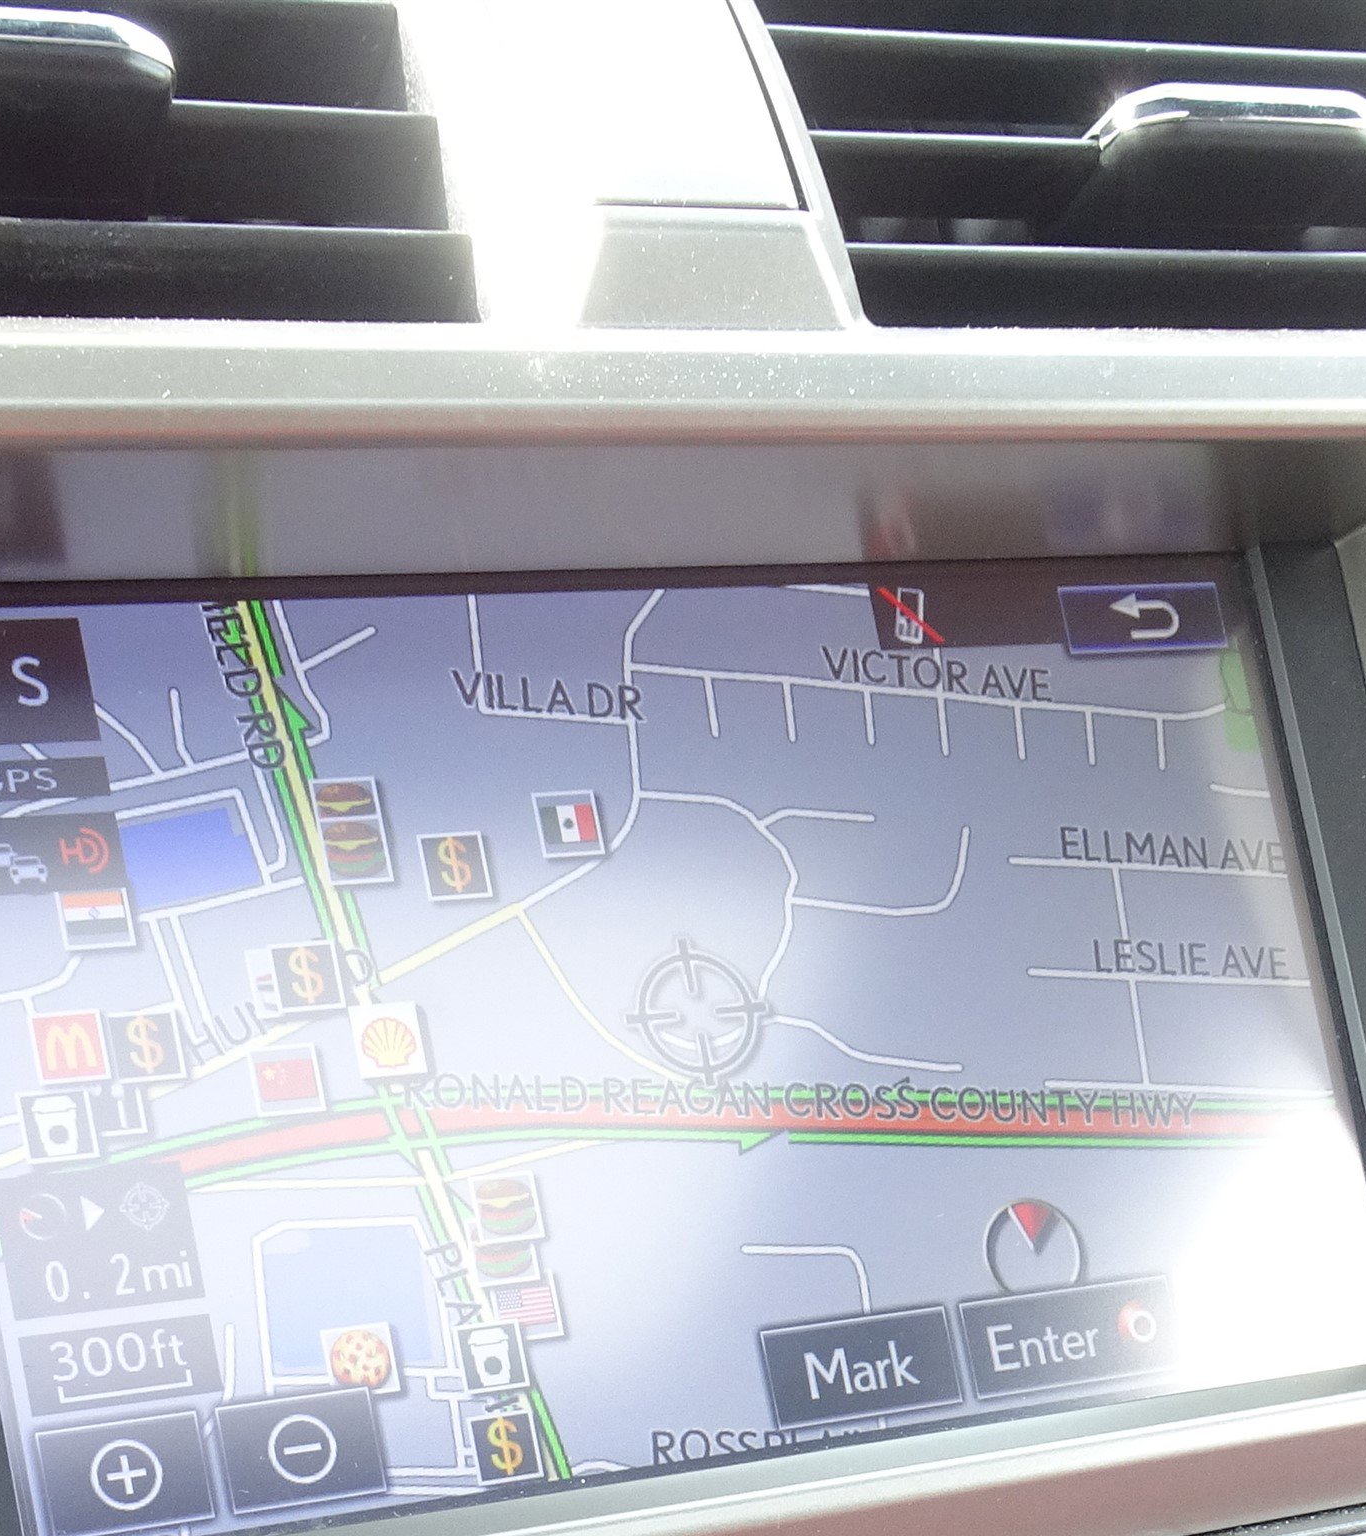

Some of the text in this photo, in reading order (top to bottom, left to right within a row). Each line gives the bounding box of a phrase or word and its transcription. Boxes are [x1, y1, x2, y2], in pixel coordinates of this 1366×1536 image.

[11, 656, 49, 707] S
[451, 670, 644, 721] VILLA DR
[821, 645, 1053, 702] VICTOR AVE
[237, 710, 286, 769] RD
[1060, 826, 1287, 874] ELLMAN AVE
[1093, 938, 1289, 980] LESLIE AVE
[603, 1078, 772, 1118] REAGAN
[784, 1080, 920, 1121] CROSS
[930, 1086, 1097, 1126] COUNTY
[1110, 1092, 1198, 1127] HWY
[50, 1328, 188, 1383] 300ft
[803, 1341, 920, 1400] Mark
[986, 1323, 1099, 1374] Enter
